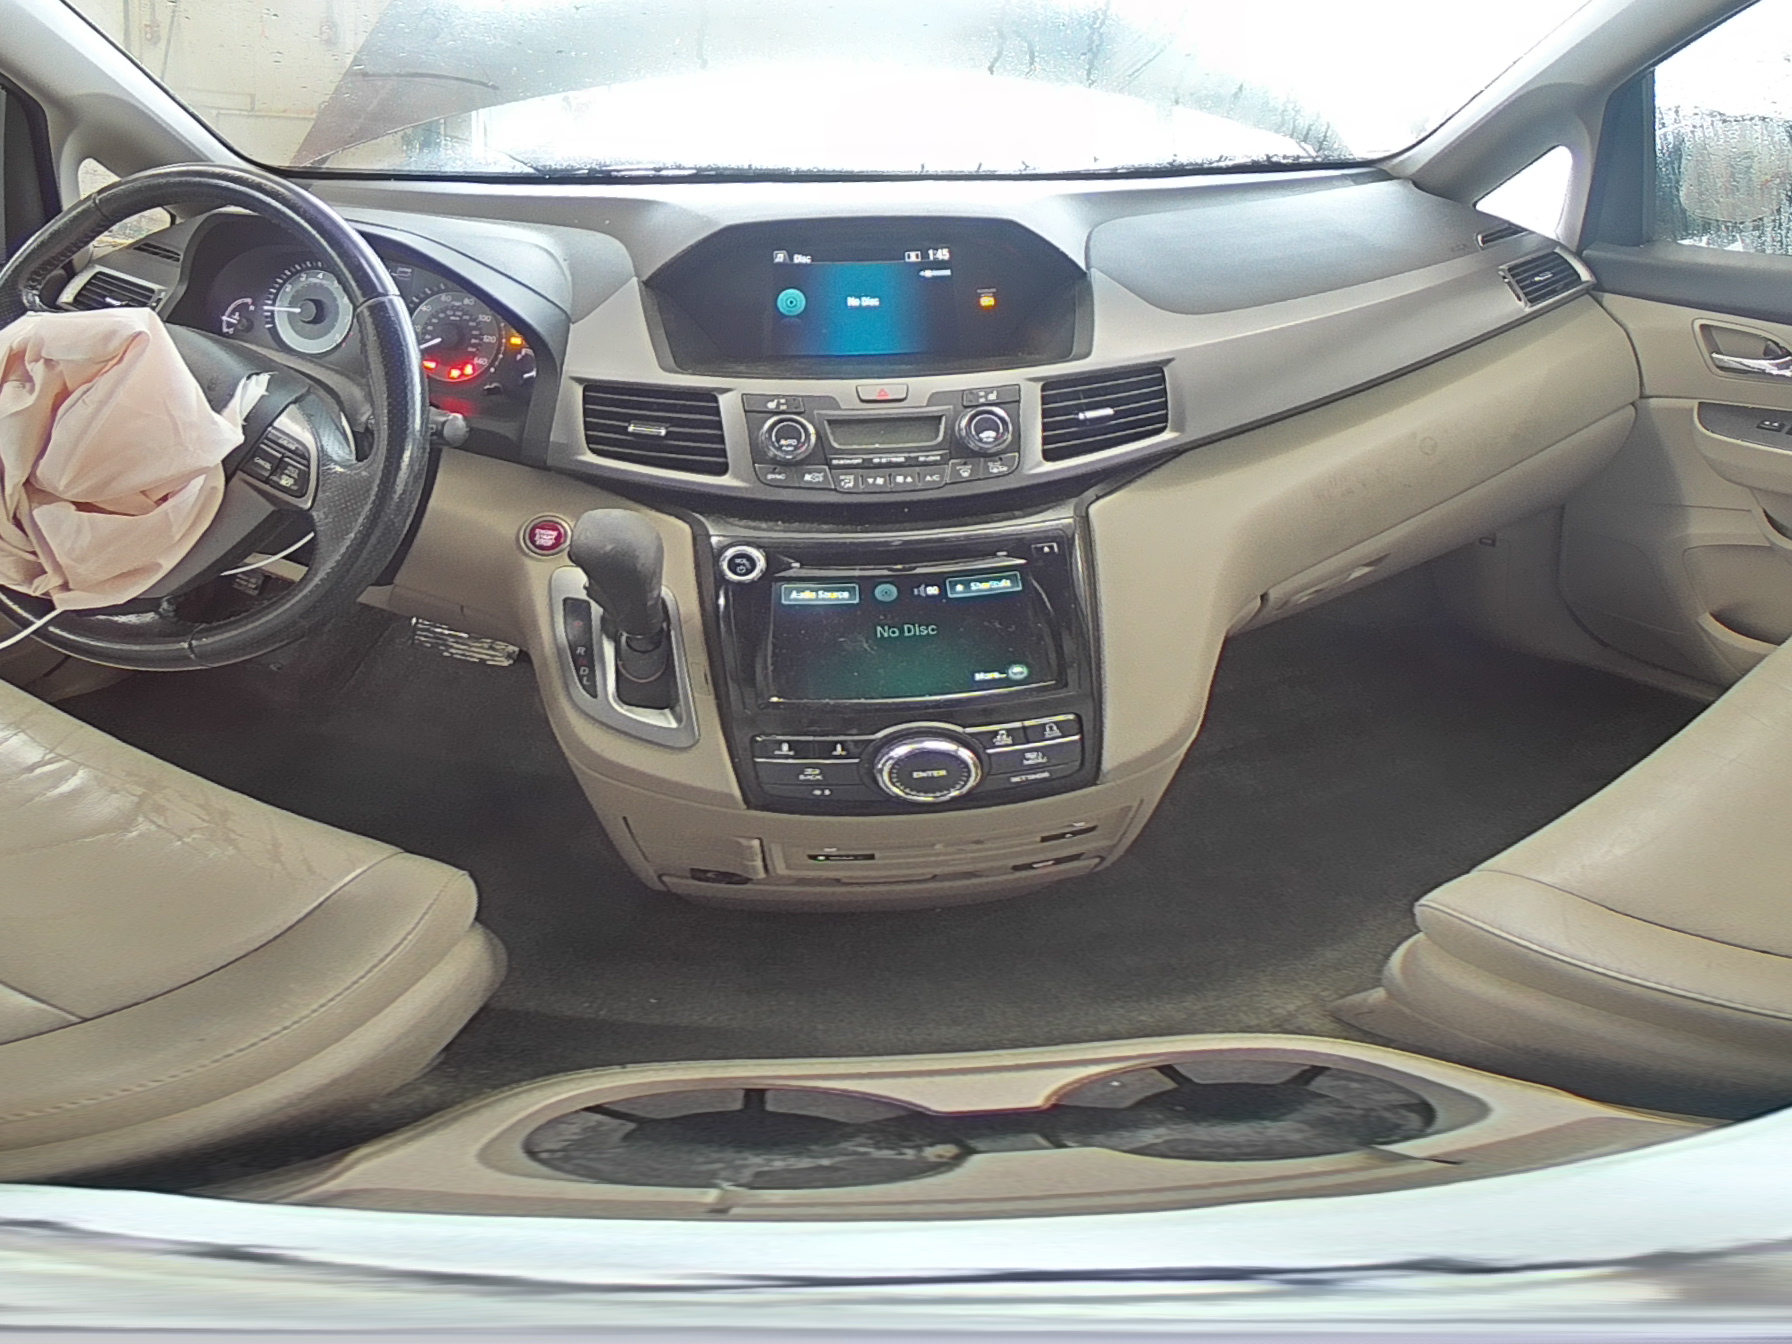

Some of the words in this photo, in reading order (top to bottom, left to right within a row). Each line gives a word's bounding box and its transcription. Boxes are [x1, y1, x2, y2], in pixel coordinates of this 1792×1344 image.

[928, 249, 950, 261] 1:45
[478, 314, 492, 323] 100
[482, 335, 497, 344] 120
[924, 474, 941, 482] A/C
[876, 625, 899, 638] No
[903, 623, 938, 637] Disc
[912, 769, 948, 779] ENTER
